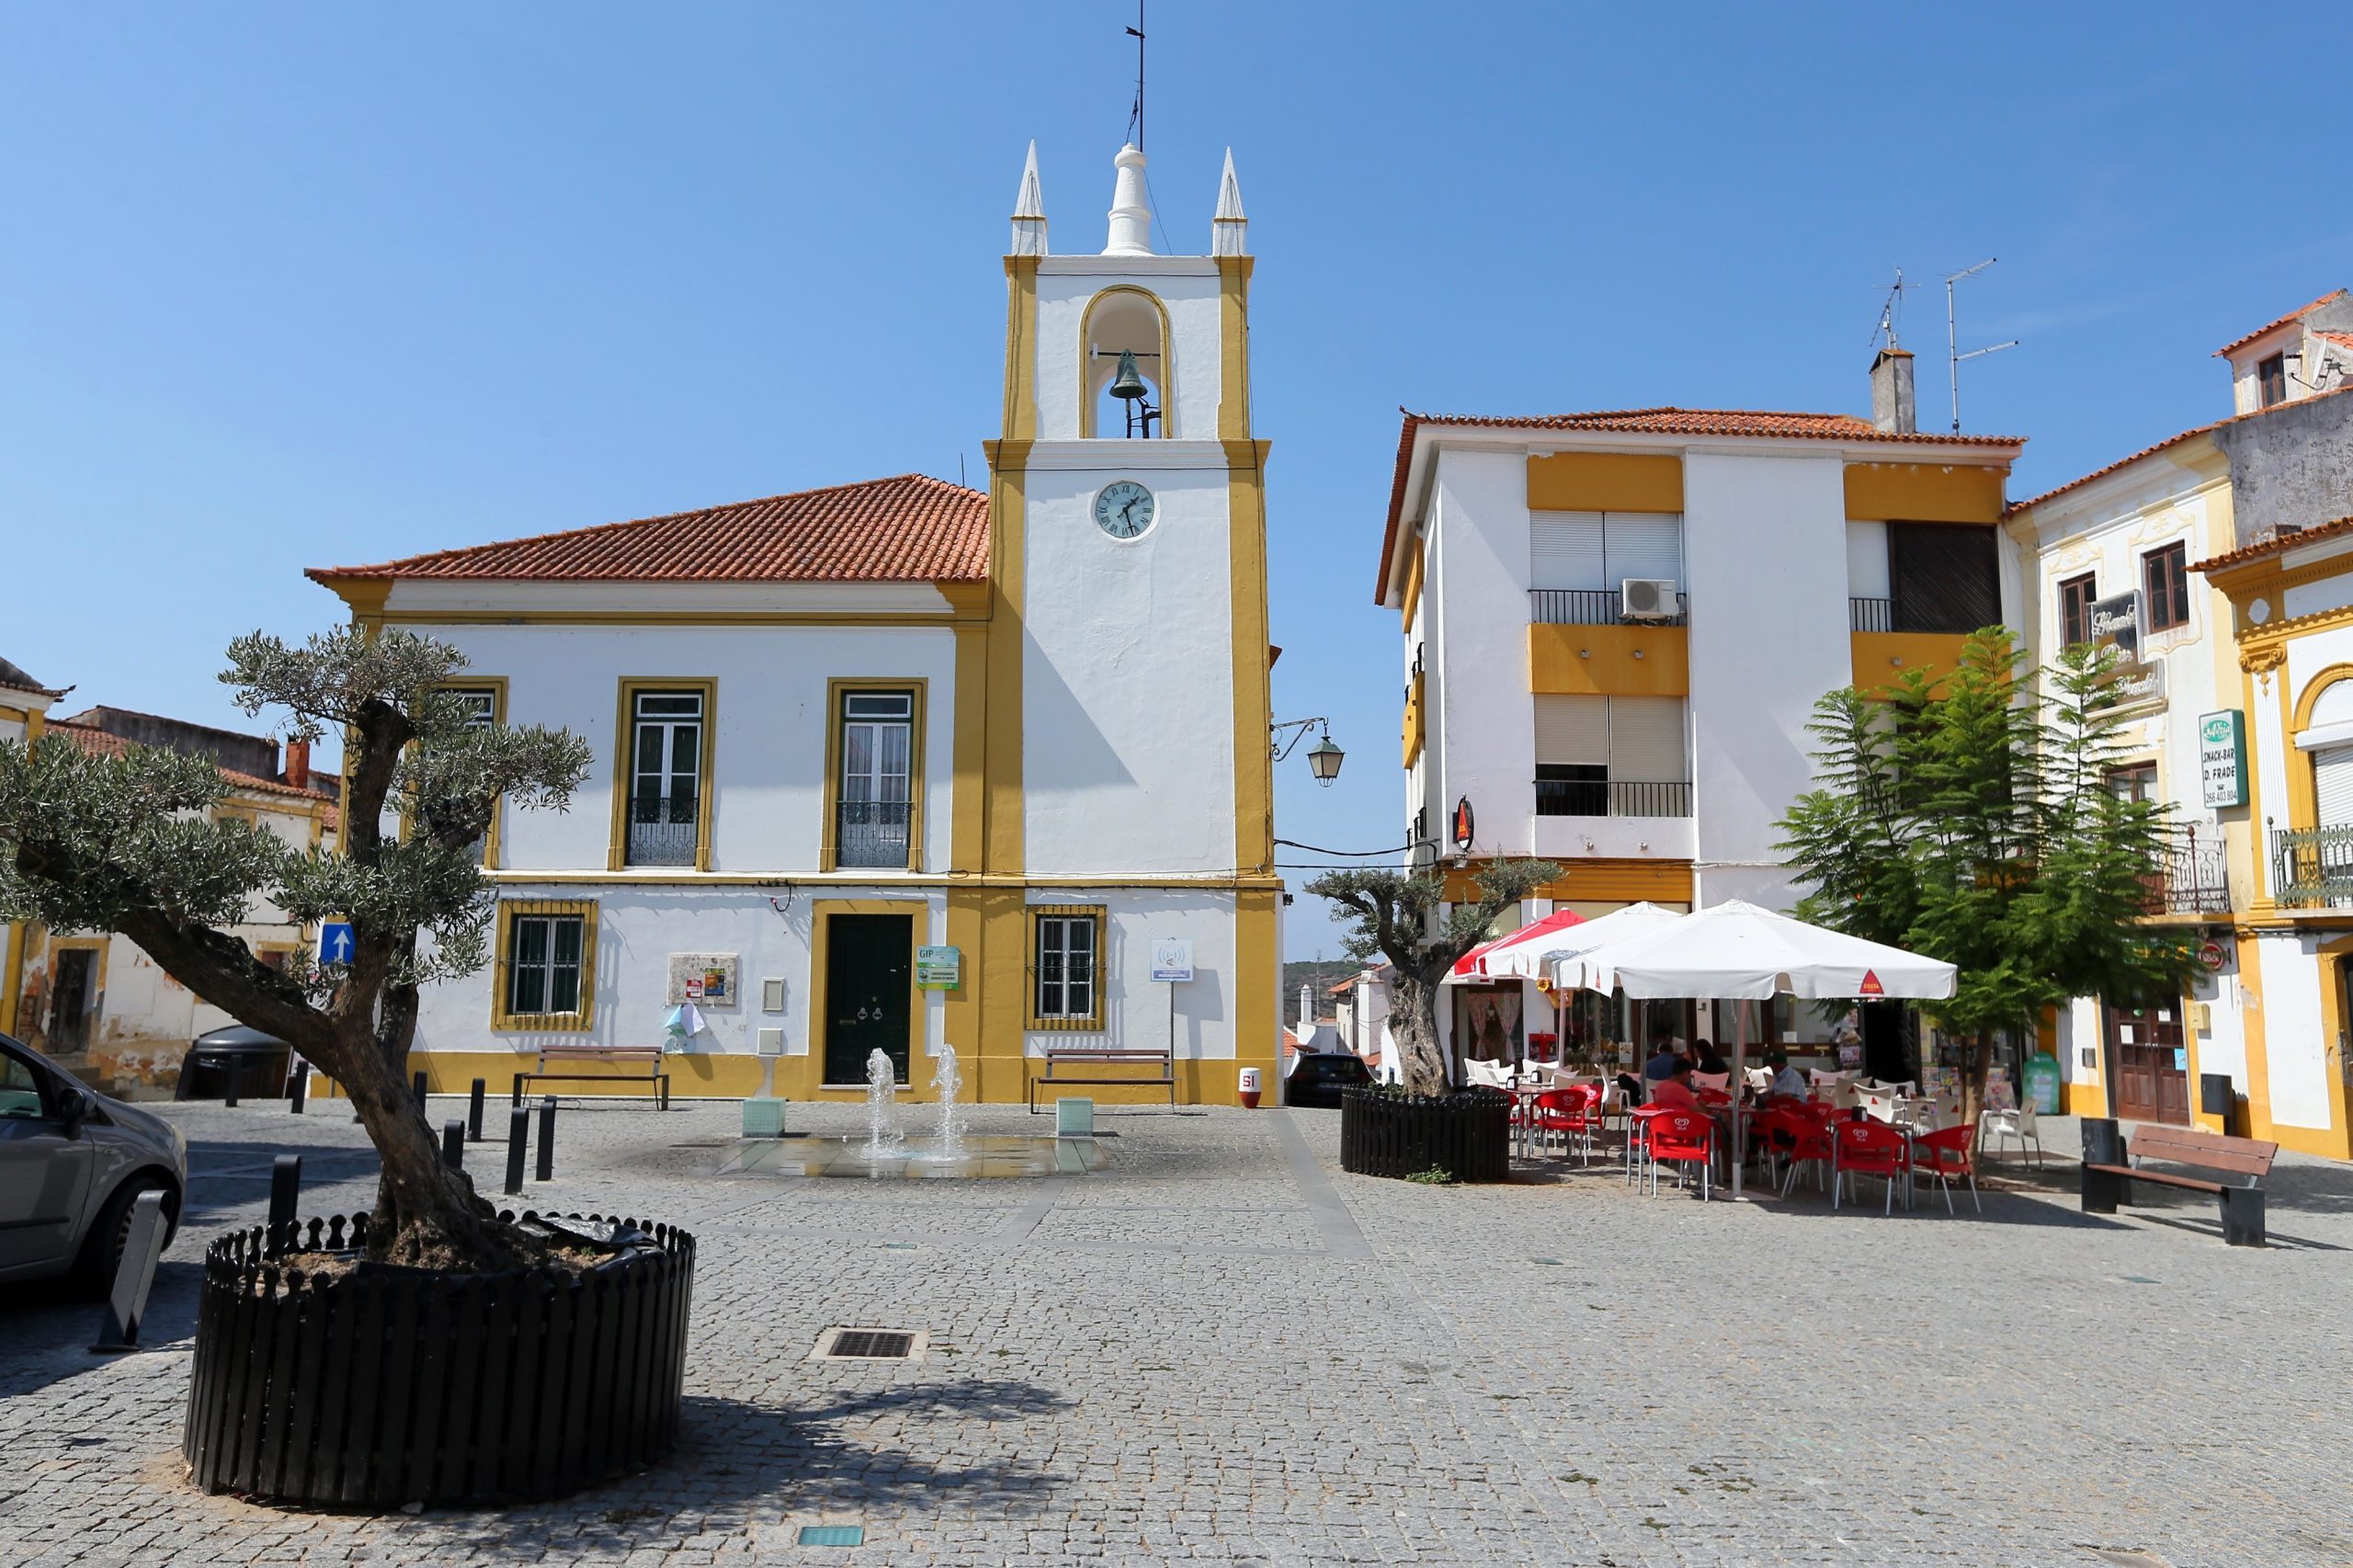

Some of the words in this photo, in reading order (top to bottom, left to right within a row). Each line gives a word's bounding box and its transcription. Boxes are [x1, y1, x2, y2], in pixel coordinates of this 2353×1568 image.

[2204, 748, 2234, 763] SNACK-BAR
[2212, 766, 2235, 779] FRADE
[920, 950, 933, 958] GIP
